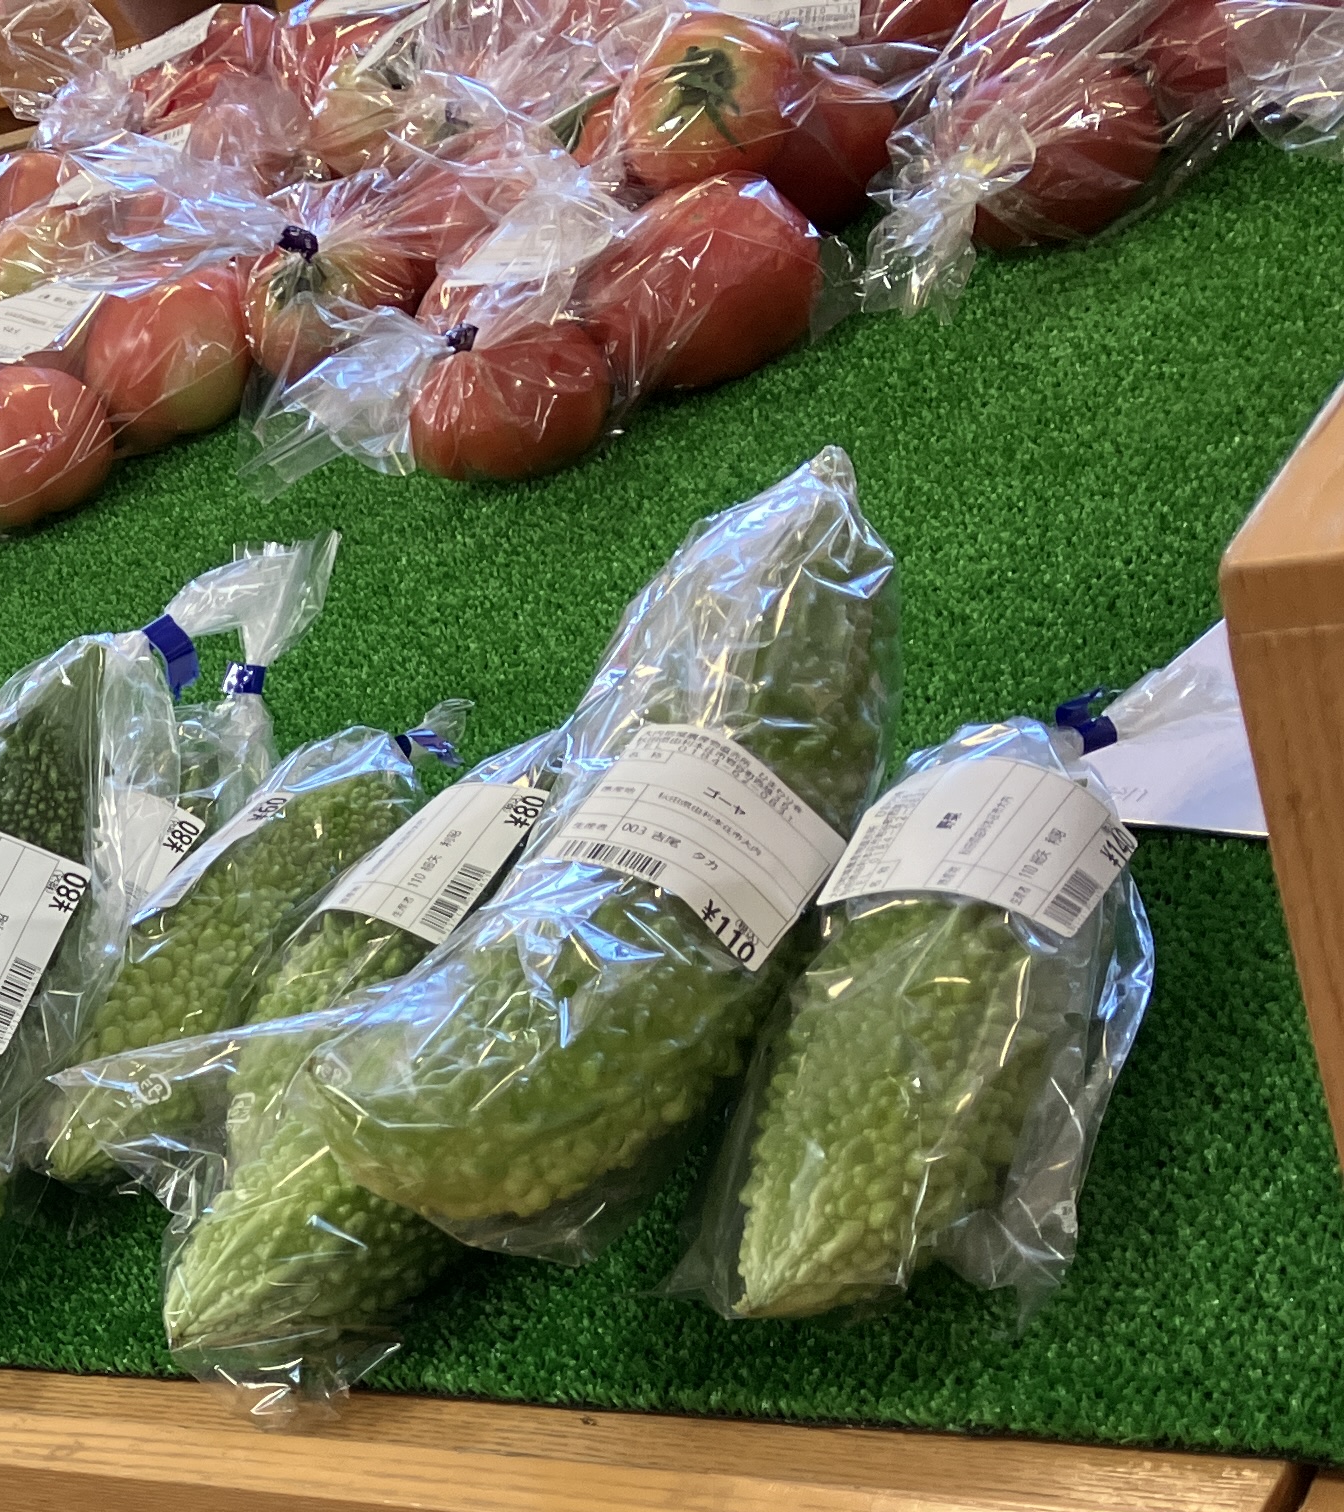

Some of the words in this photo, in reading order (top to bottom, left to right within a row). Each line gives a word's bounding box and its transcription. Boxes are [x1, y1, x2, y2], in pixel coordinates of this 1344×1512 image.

[503, 787, 546, 835] ¥80
[700, 784, 749, 819] ゴーヤ
[162, 815, 202, 858] ¥80
[620, 816, 648, 841] 003
[1096, 824, 1139, 869] ¥140
[48, 868, 89, 917] ¥80
[407, 869, 427, 891] 110
[688, 897, 767, 966] ¥110
